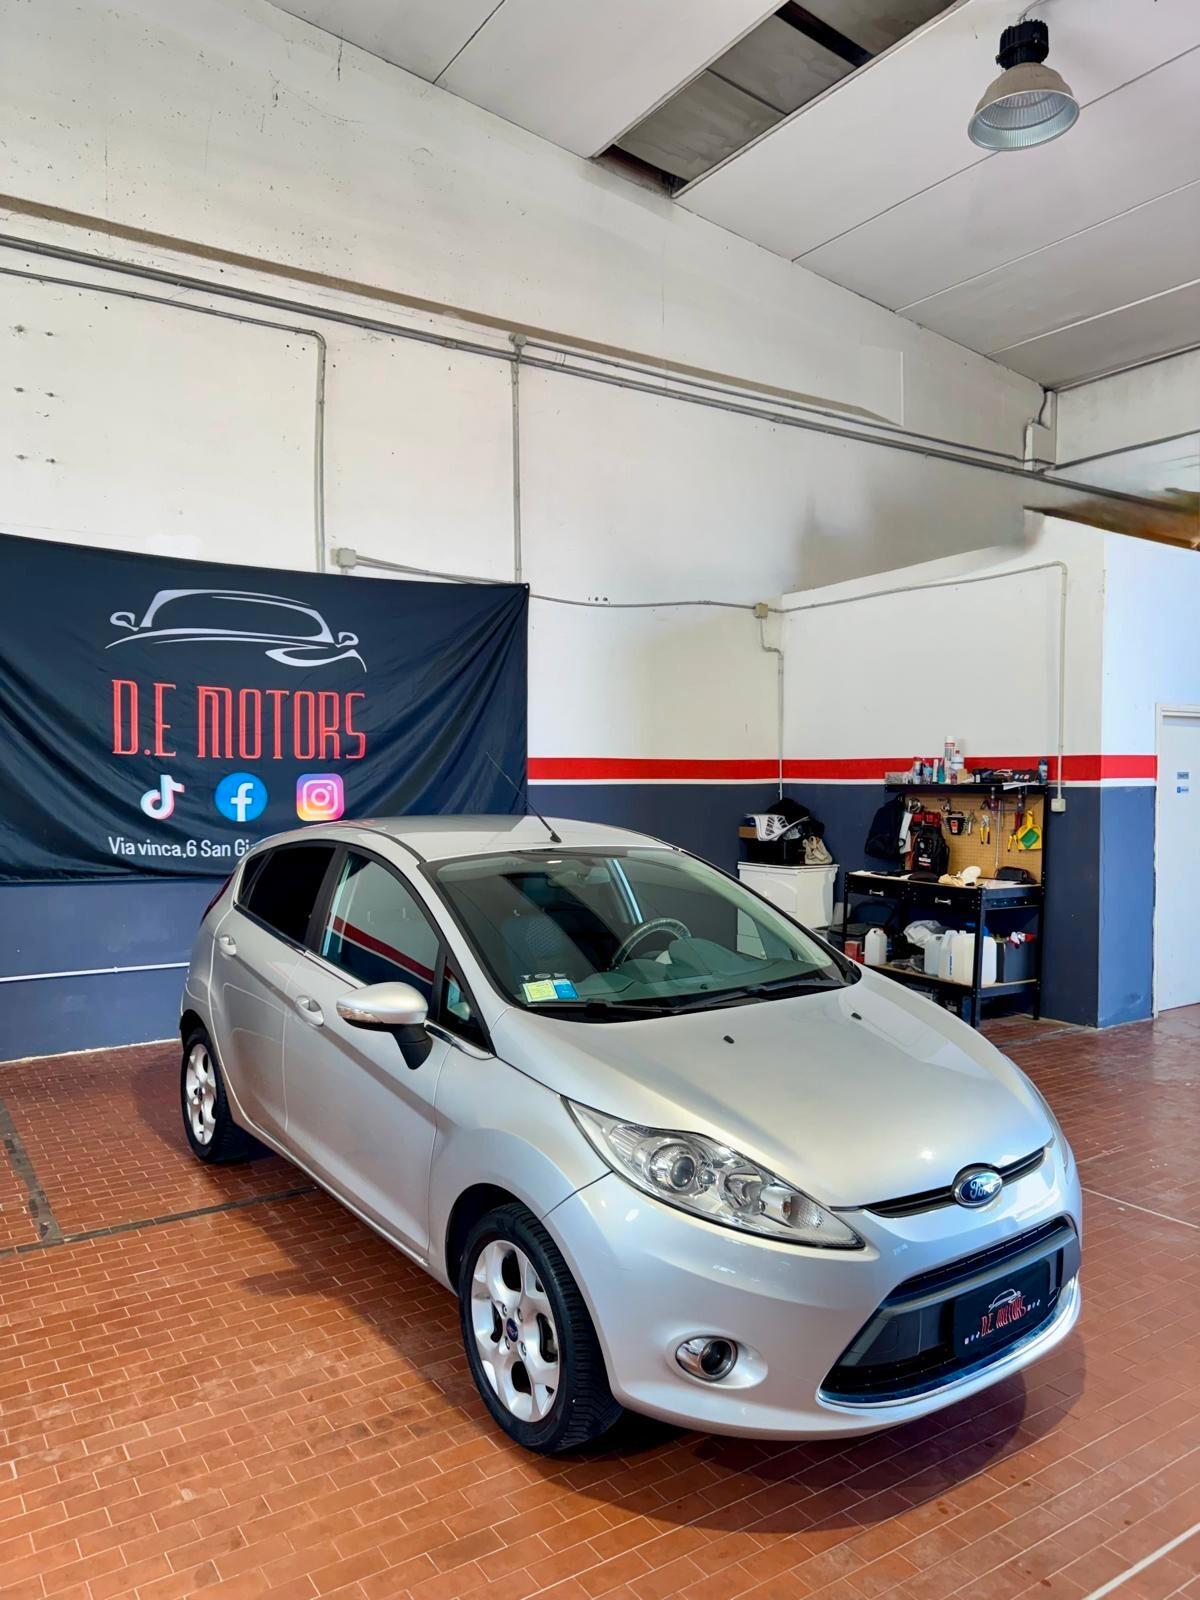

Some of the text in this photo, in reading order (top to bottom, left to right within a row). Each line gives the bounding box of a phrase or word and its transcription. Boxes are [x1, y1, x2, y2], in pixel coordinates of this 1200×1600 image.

[111, 679, 367, 760] D.E MOTORS
[108, 836, 136, 855] Via
[200, 839, 231, 857] San
[234, 838, 256, 857] Gi
[970, 1179, 997, 1200] Fo
